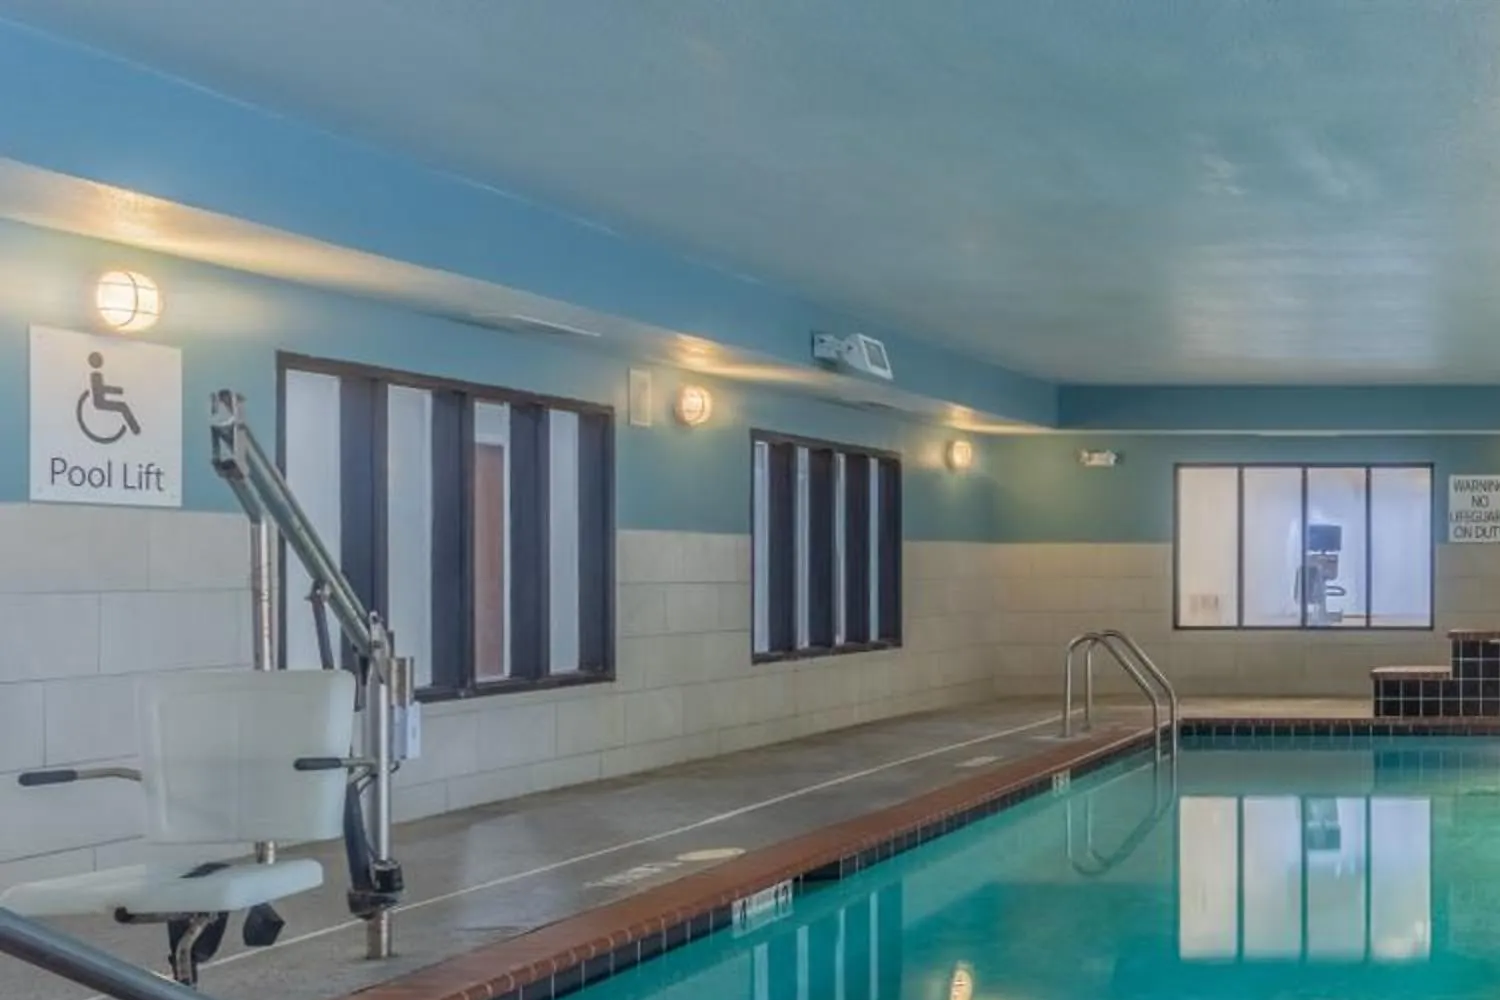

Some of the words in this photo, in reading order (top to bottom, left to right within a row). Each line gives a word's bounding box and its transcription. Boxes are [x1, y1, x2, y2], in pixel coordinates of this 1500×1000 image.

[50, 457, 113, 489] Pool
[123, 462, 164, 492] Lift
[1471, 495, 1489, 509] NO
[1453, 526, 1473, 539] ON
